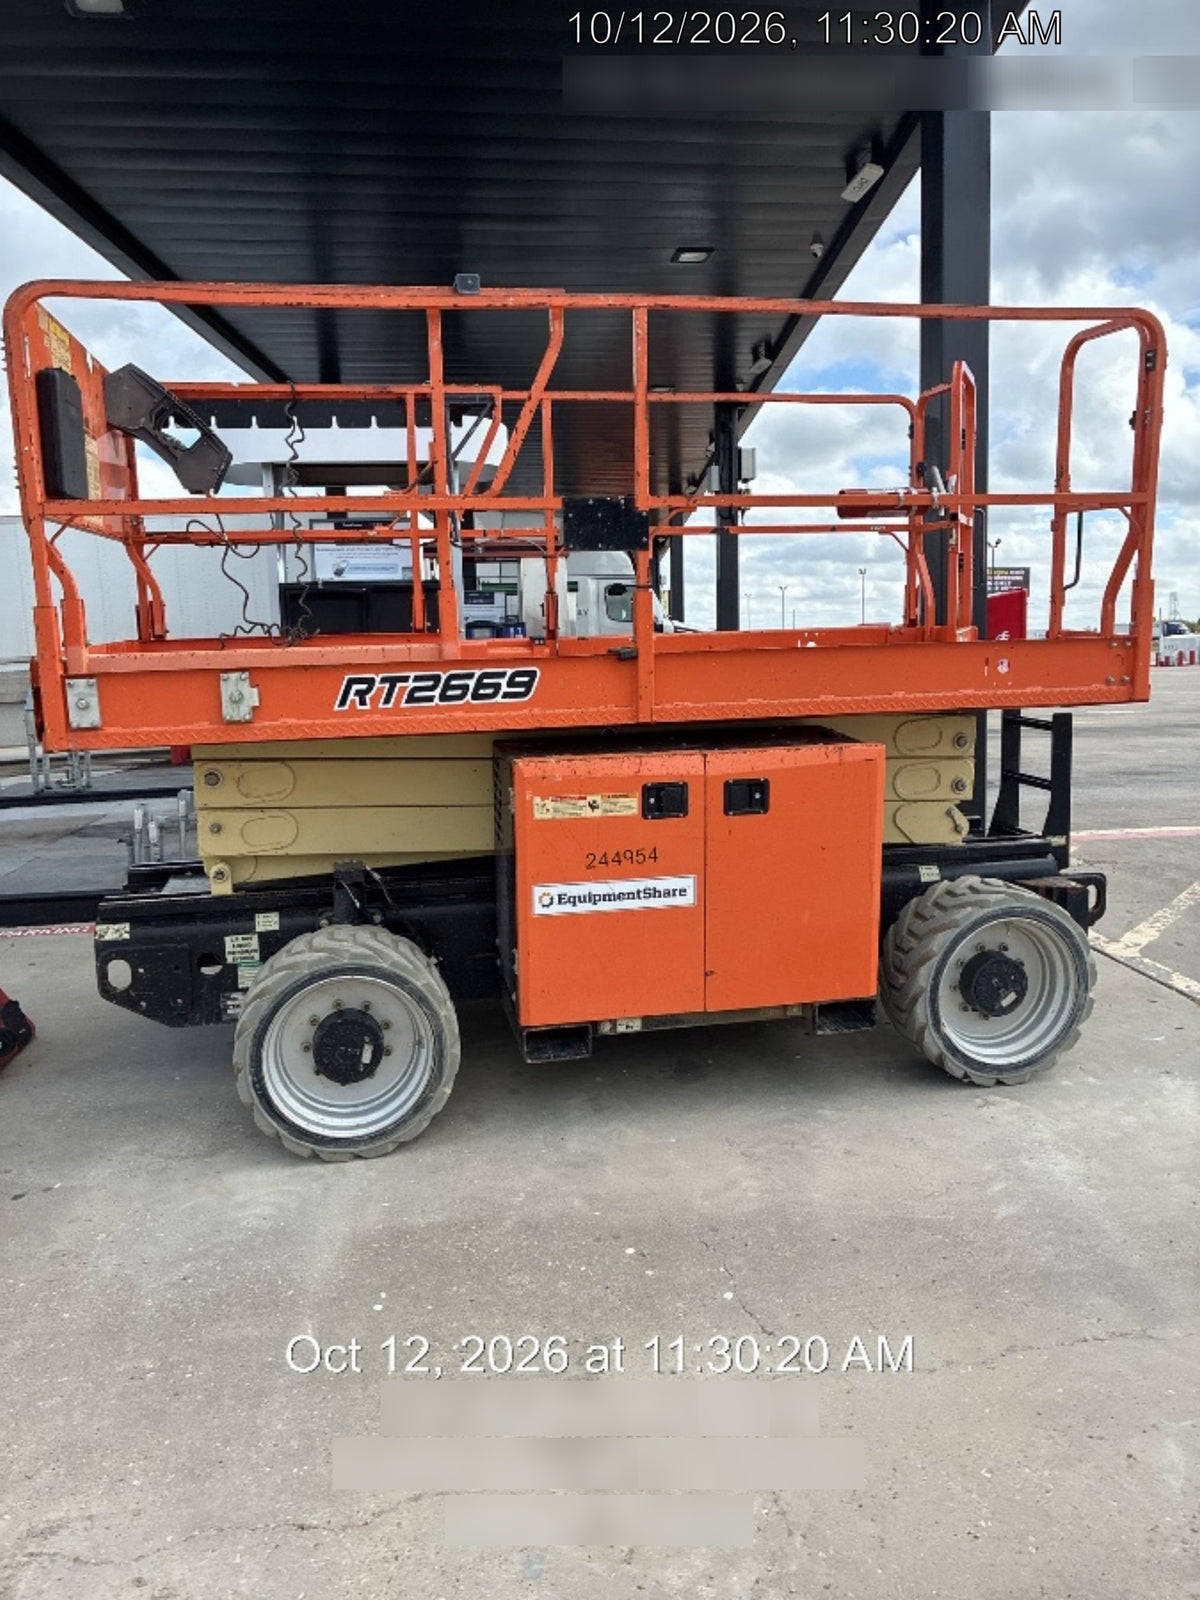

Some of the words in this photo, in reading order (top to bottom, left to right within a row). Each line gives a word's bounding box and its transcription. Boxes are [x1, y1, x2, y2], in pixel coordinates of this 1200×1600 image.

[335, 668, 539, 709] RT2669
[586, 847, 659, 870] 244954
[557, 887, 687, 907] EquipmentShare
